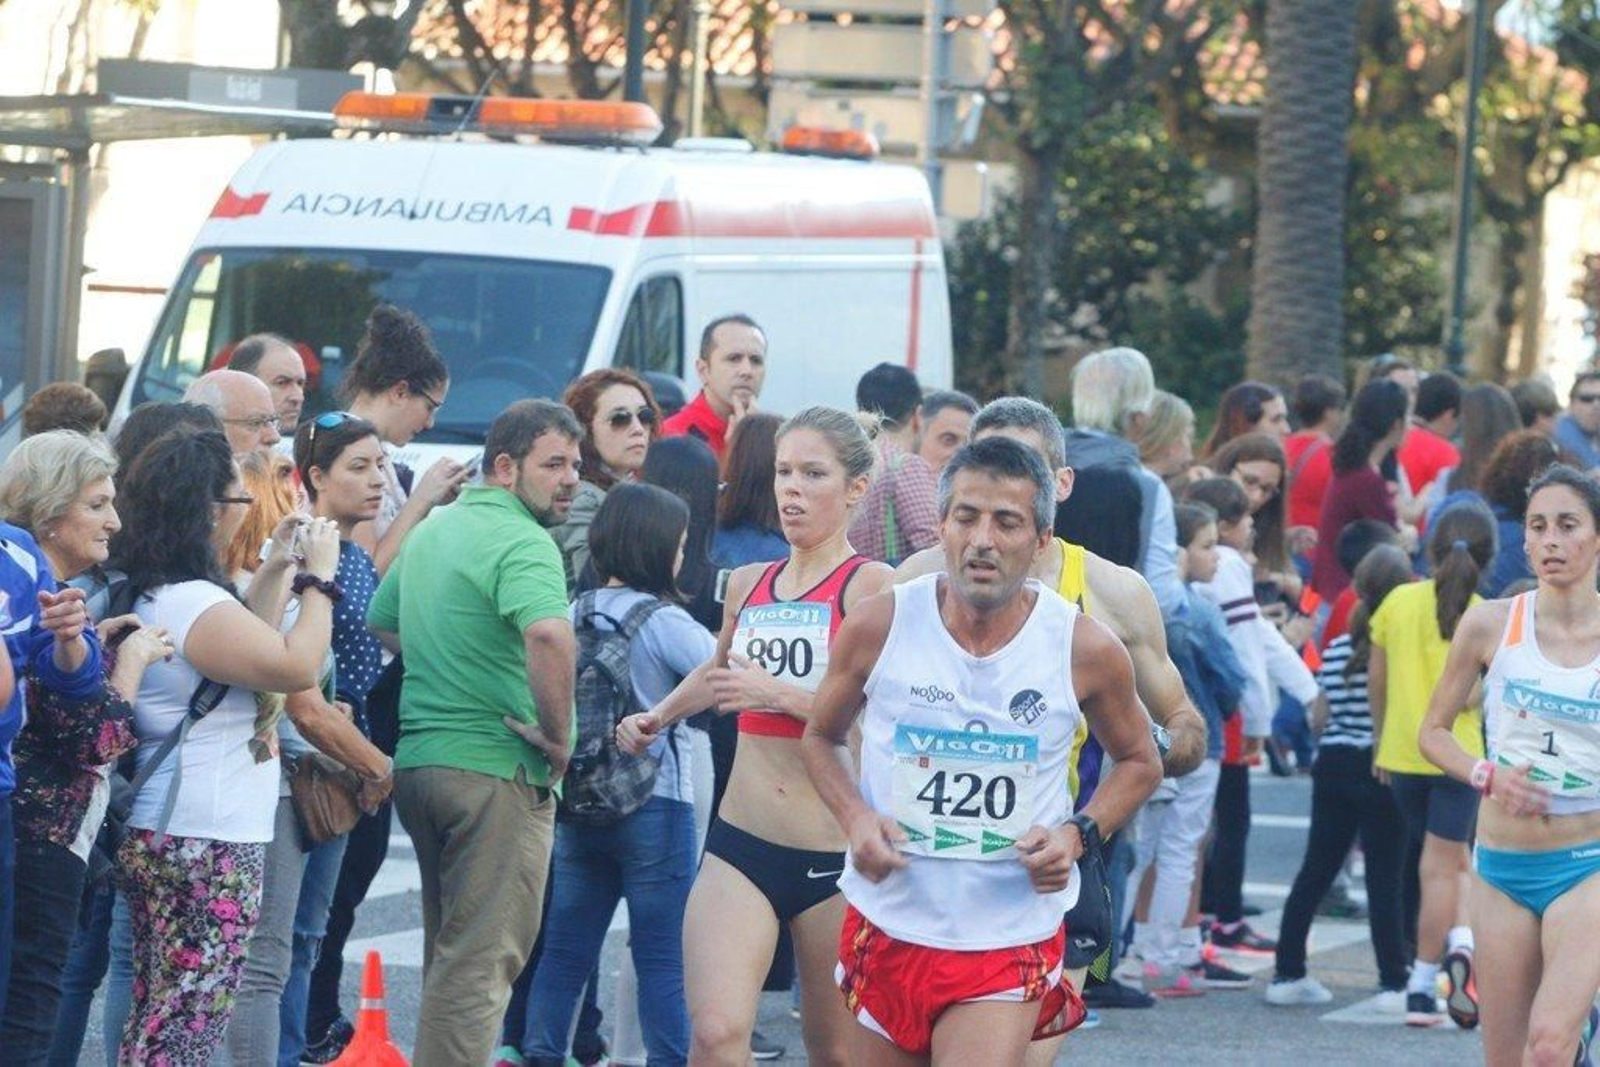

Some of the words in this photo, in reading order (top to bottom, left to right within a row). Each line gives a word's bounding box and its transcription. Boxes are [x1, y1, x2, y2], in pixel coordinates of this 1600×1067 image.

[746, 637, 813, 677] 890
[1022, 702, 1048, 725] Life
[1540, 731, 1559, 757] 1
[916, 770, 1017, 820] 420
